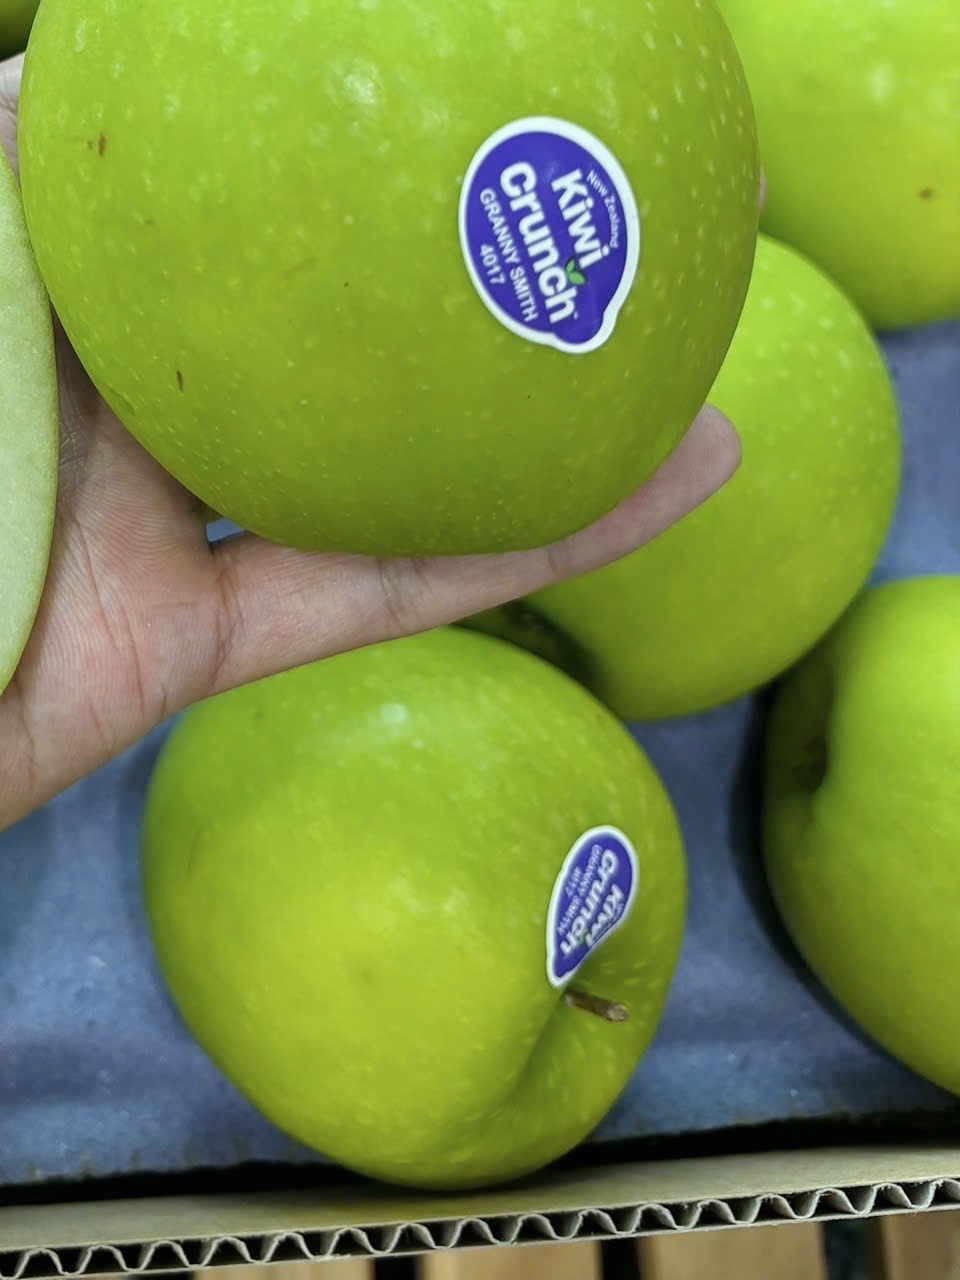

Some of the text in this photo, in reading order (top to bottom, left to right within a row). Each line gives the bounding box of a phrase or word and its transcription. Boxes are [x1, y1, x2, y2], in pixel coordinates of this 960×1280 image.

[480, 188, 539, 322] GRANNY SMITH
[500, 161, 579, 324] Crunch
[551, 169, 611, 269] Kiwi
[586, 170, 621, 249] New Zealand
[480, 244, 506, 285] 4017
[559, 849, 619, 956] Crunch
[585, 883, 625, 948] Kiwi
